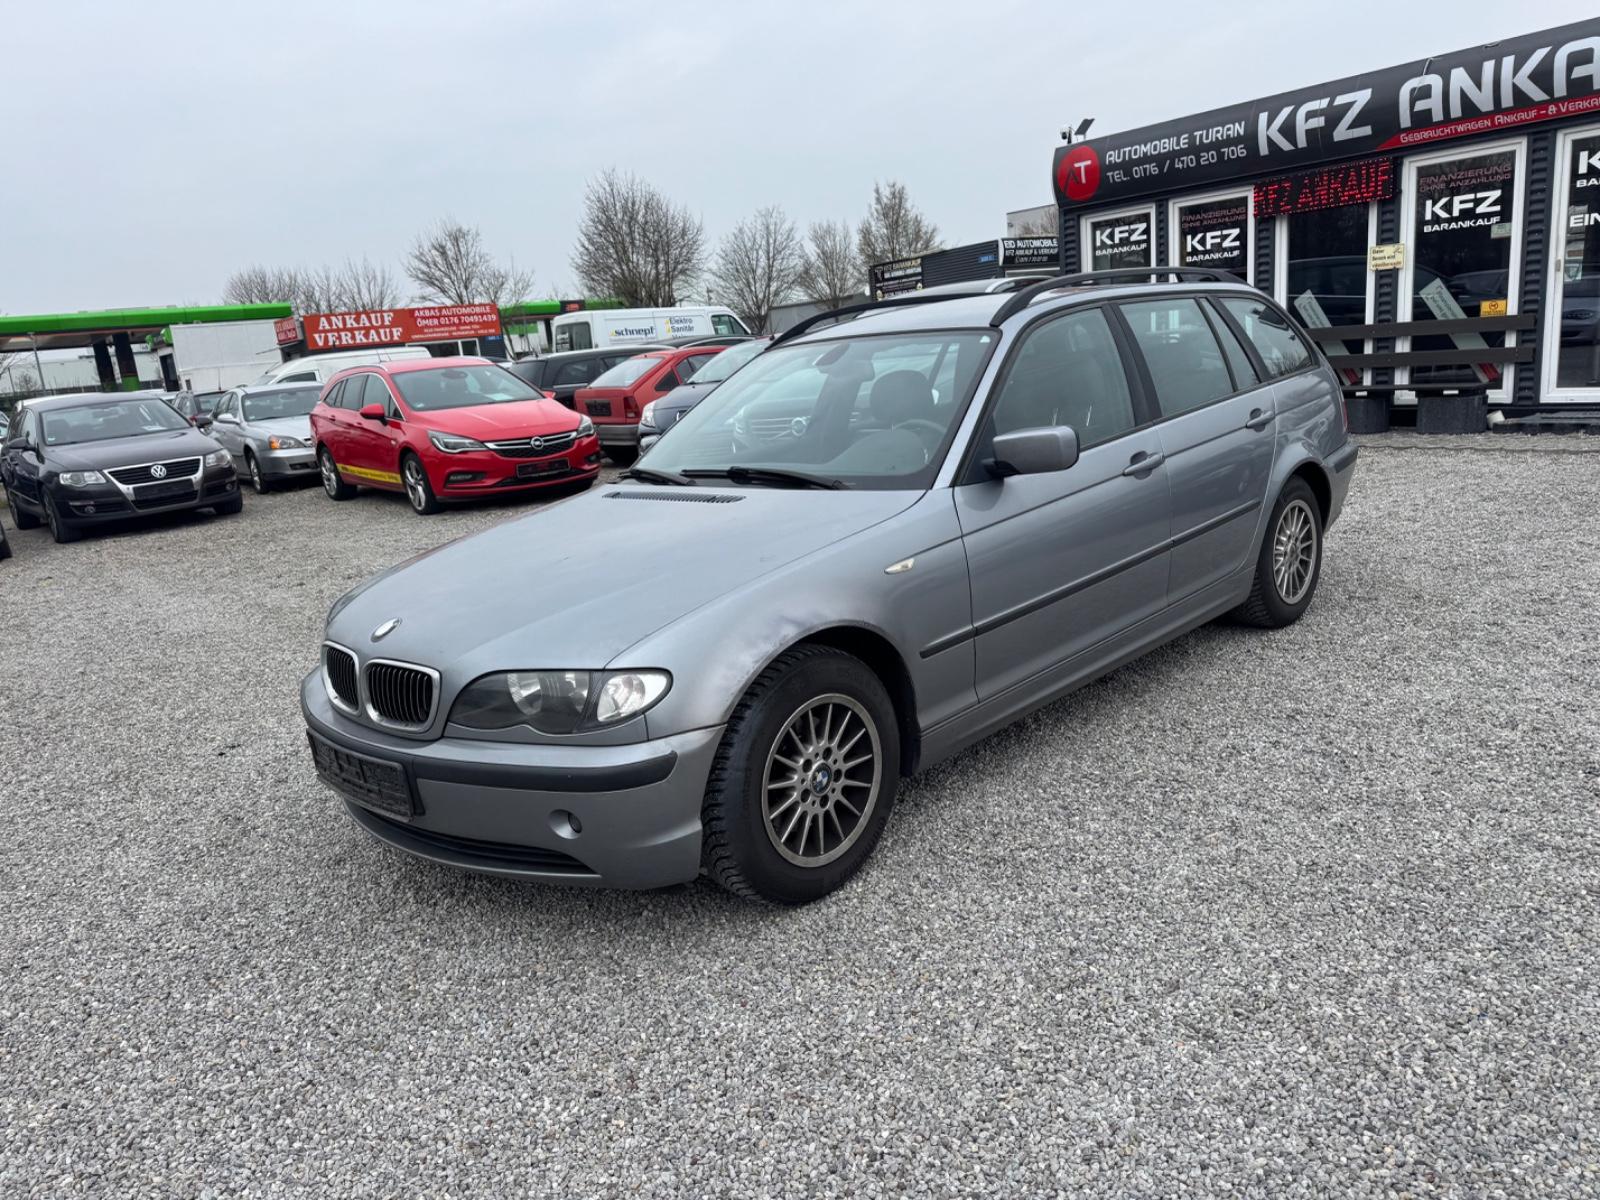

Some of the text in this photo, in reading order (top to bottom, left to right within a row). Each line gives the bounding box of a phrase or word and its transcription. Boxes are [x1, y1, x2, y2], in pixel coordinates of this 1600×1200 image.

[1258, 36, 1600, 156] KFZ ANKA
[1400, 118, 1491, 143] GEBRAUCHTWAGEN
[1494, 109, 1537, 125] ANKAUF
[1559, 97, 1600, 112] VERKA
[1105, 121, 1245, 165] AUTOMOBILE TURAN
[1106, 171, 1130, 184] TEL.
[1132, 163, 1159, 179] 0176
[1174, 155, 1197, 170] 470
[1199, 150, 1217, 165] 20
[1221, 144, 1247, 161] 706
[1420, 164, 1512, 184] FINANZIERUNG
[1420, 173, 1511, 192] OHNE ANZAHLUNG
[1576, 178, 1600, 187] BA
[1254, 161, 1390, 217] KFZ ANKAUF
[1425, 189, 1502, 220] KFZ
[1181, 207, 1246, 222] FINANZIERUNG
[1423, 216, 1501, 233] BARANKAUF
[1095, 222, 1147, 247] KFZ
[1186, 227, 1240, 252] KFZ
[1095, 243, 1147, 256] BARANKAUF
[1186, 250, 1240, 262] BARANKAUF
[439, 316, 459, 325] 0176
[441, 306, 491, 316] AUTOMOBILE
[318, 312, 395, 330] ANKAUF
[313, 327, 403, 347] VERKAUF
[614, 326, 654, 337] schnepf
